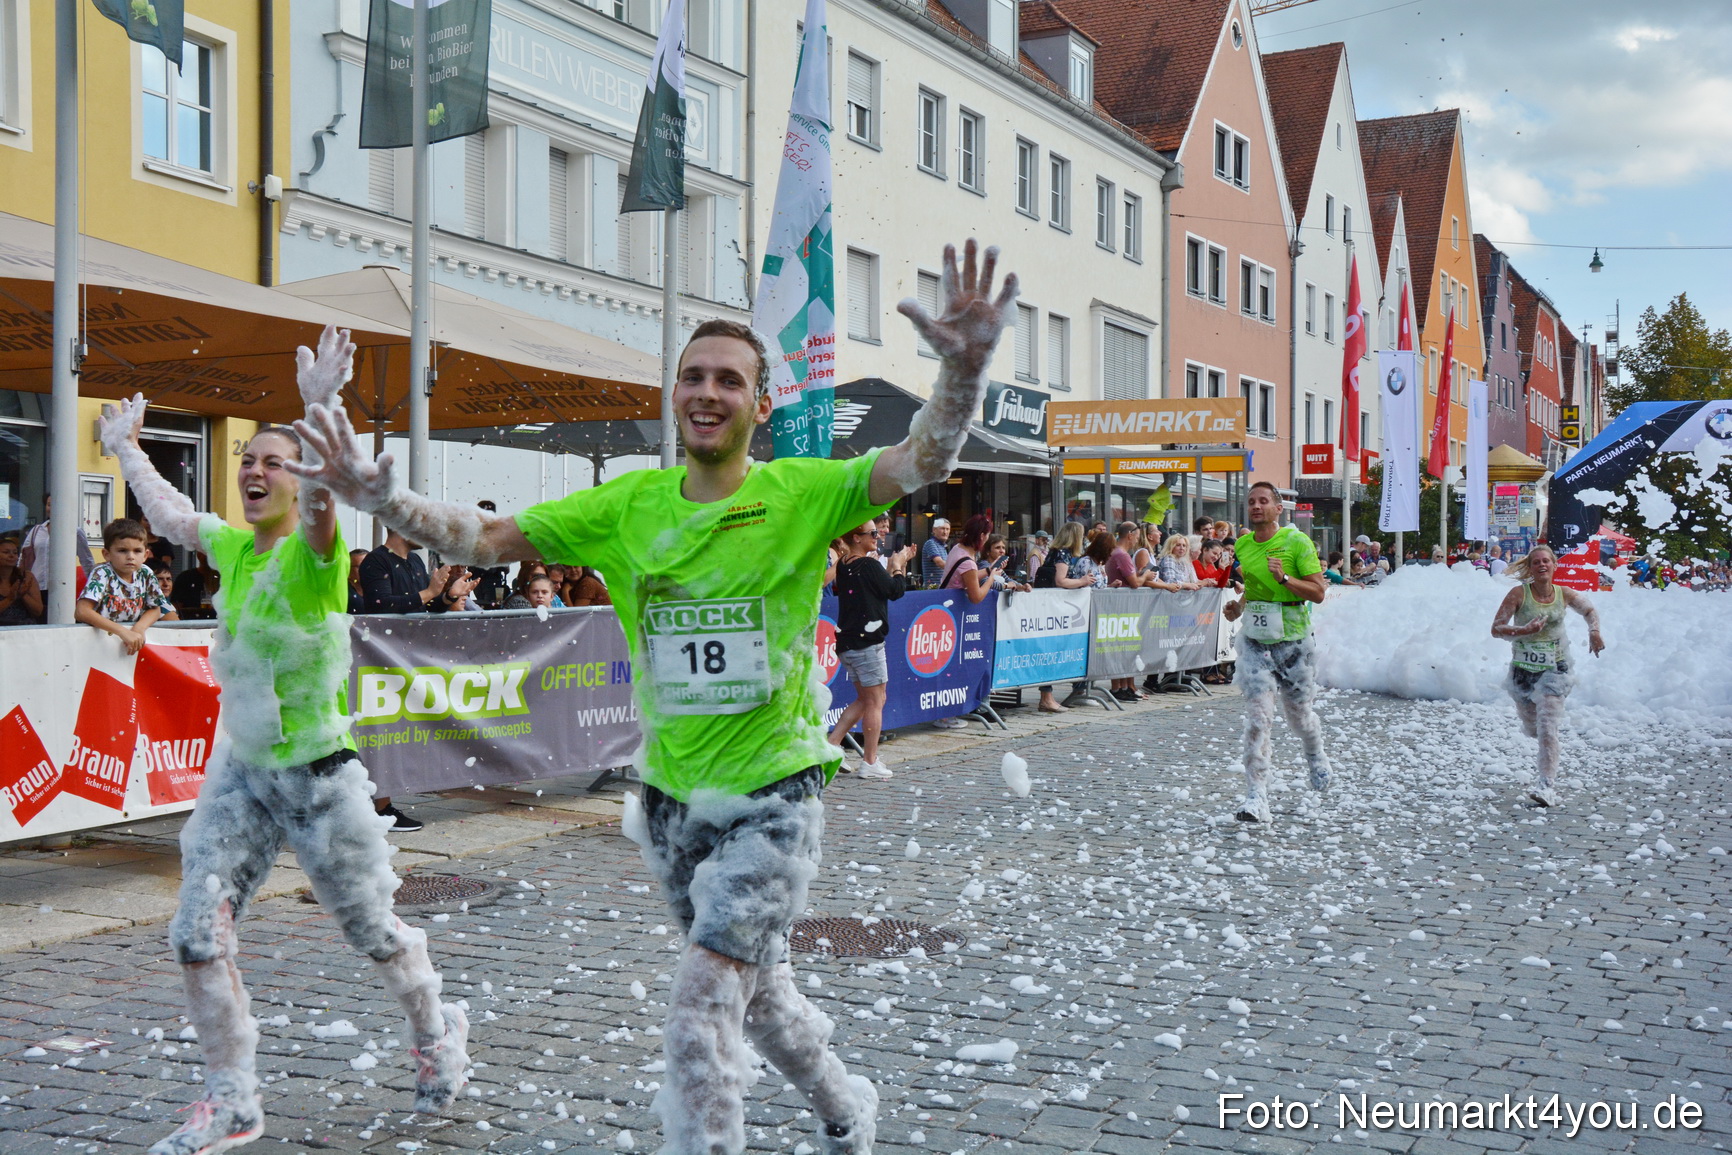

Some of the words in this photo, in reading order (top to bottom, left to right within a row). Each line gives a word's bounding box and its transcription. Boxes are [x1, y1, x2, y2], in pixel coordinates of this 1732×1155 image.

[390, 55, 410, 70] bei
[437, 41, 473, 62] BioBier
[490, 23, 563, 85] RILLEN
[988, 388, 1047, 435] frühauf
[1118, 459, 1189, 470] RUNMARKT.DE
[1306, 453, 1328, 462] WITT
[1565, 464, 1595, 484] PARTL
[1594, 433, 1644, 468] NEUMARKT
[651, 604, 752, 629] BOCK
[966, 614, 979, 623] STORE
[1021, 615, 1069, 632] RAIL.ONE
[1097, 617, 1139, 639] BOCK
[910, 624, 953, 660] Hervis
[965, 632, 981, 642] ONLINE
[681, 640, 727, 675] 18
[964, 650, 983, 660] MOBILE
[997, 656, 1010, 670] AUF
[1011, 654, 1031, 670] JEDER
[1031, 650, 1058, 667] STRECKE
[1058, 648, 1083, 664] ZUHAUSE
[541, 662, 606, 691] OFFICE
[611, 661, 631, 684] IN
[361, 669, 524, 718] BOCK
[920, 691, 935, 710] GET
[937, 686, 968, 708] MOVIN'
[577, 699, 638, 727] www.b
[356, 727, 410, 750] inspired
[414, 726, 430, 745] by
[434, 726, 479, 741] smart
[482, 721, 531, 740] concepts
[67, 735, 125, 785] Braun
[138, 733, 206, 773] Braun
[2, 759, 54, 810] Braun
[85, 776, 102, 789] Sicher
[102, 782, 111, 792] ist
[170, 773, 186, 785] Sicher
[29, 788, 45, 804] Sicher
